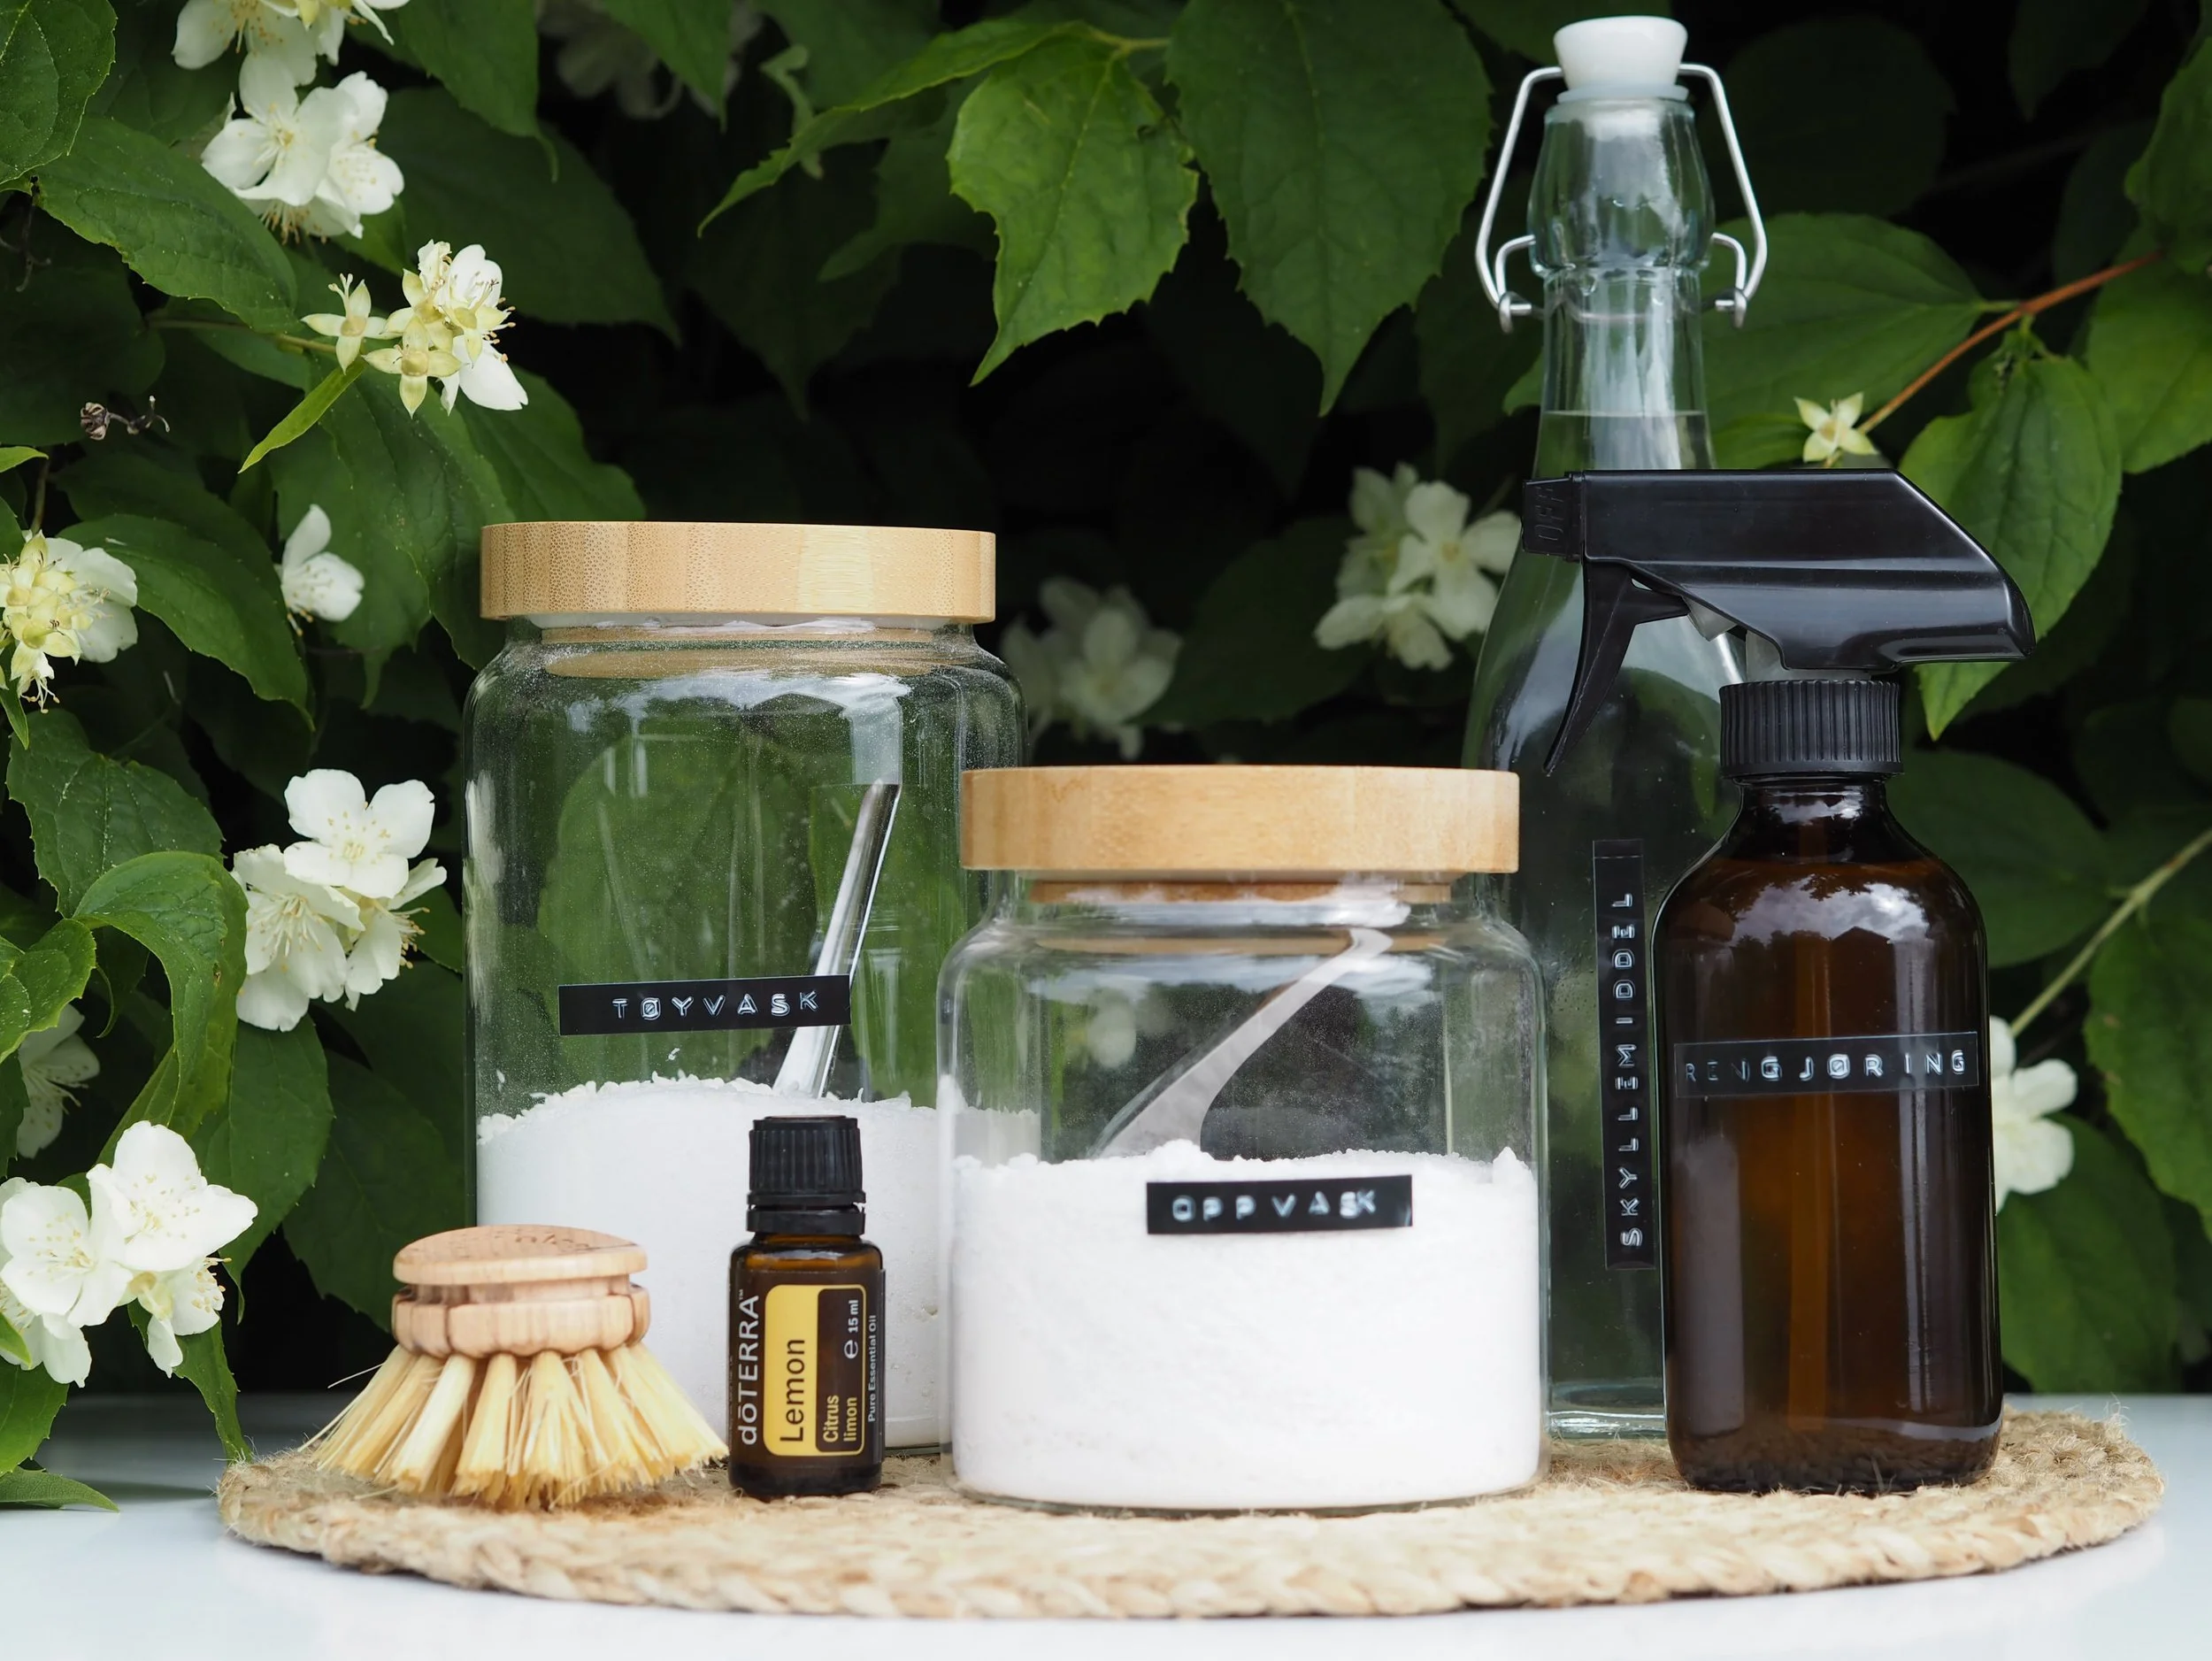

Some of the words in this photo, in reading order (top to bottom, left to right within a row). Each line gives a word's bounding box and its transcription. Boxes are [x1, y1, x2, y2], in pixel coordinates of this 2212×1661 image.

[611, 989, 819, 1021] TØYVASK
[1611, 892, 1643, 1248] SKYLLEMIDDEL
[1171, 1188, 1377, 1222] OPPVASK
[848, 1299, 859, 1315] ml
[848, 1317, 858, 1334] 15
[868, 1314, 877, 1333] Oil
[868, 1334, 877, 1391] Essential
[780, 1338, 805, 1442] Lemon
[823, 1395, 840, 1443] Citrus
[843, 1396, 857, 1442] limon
